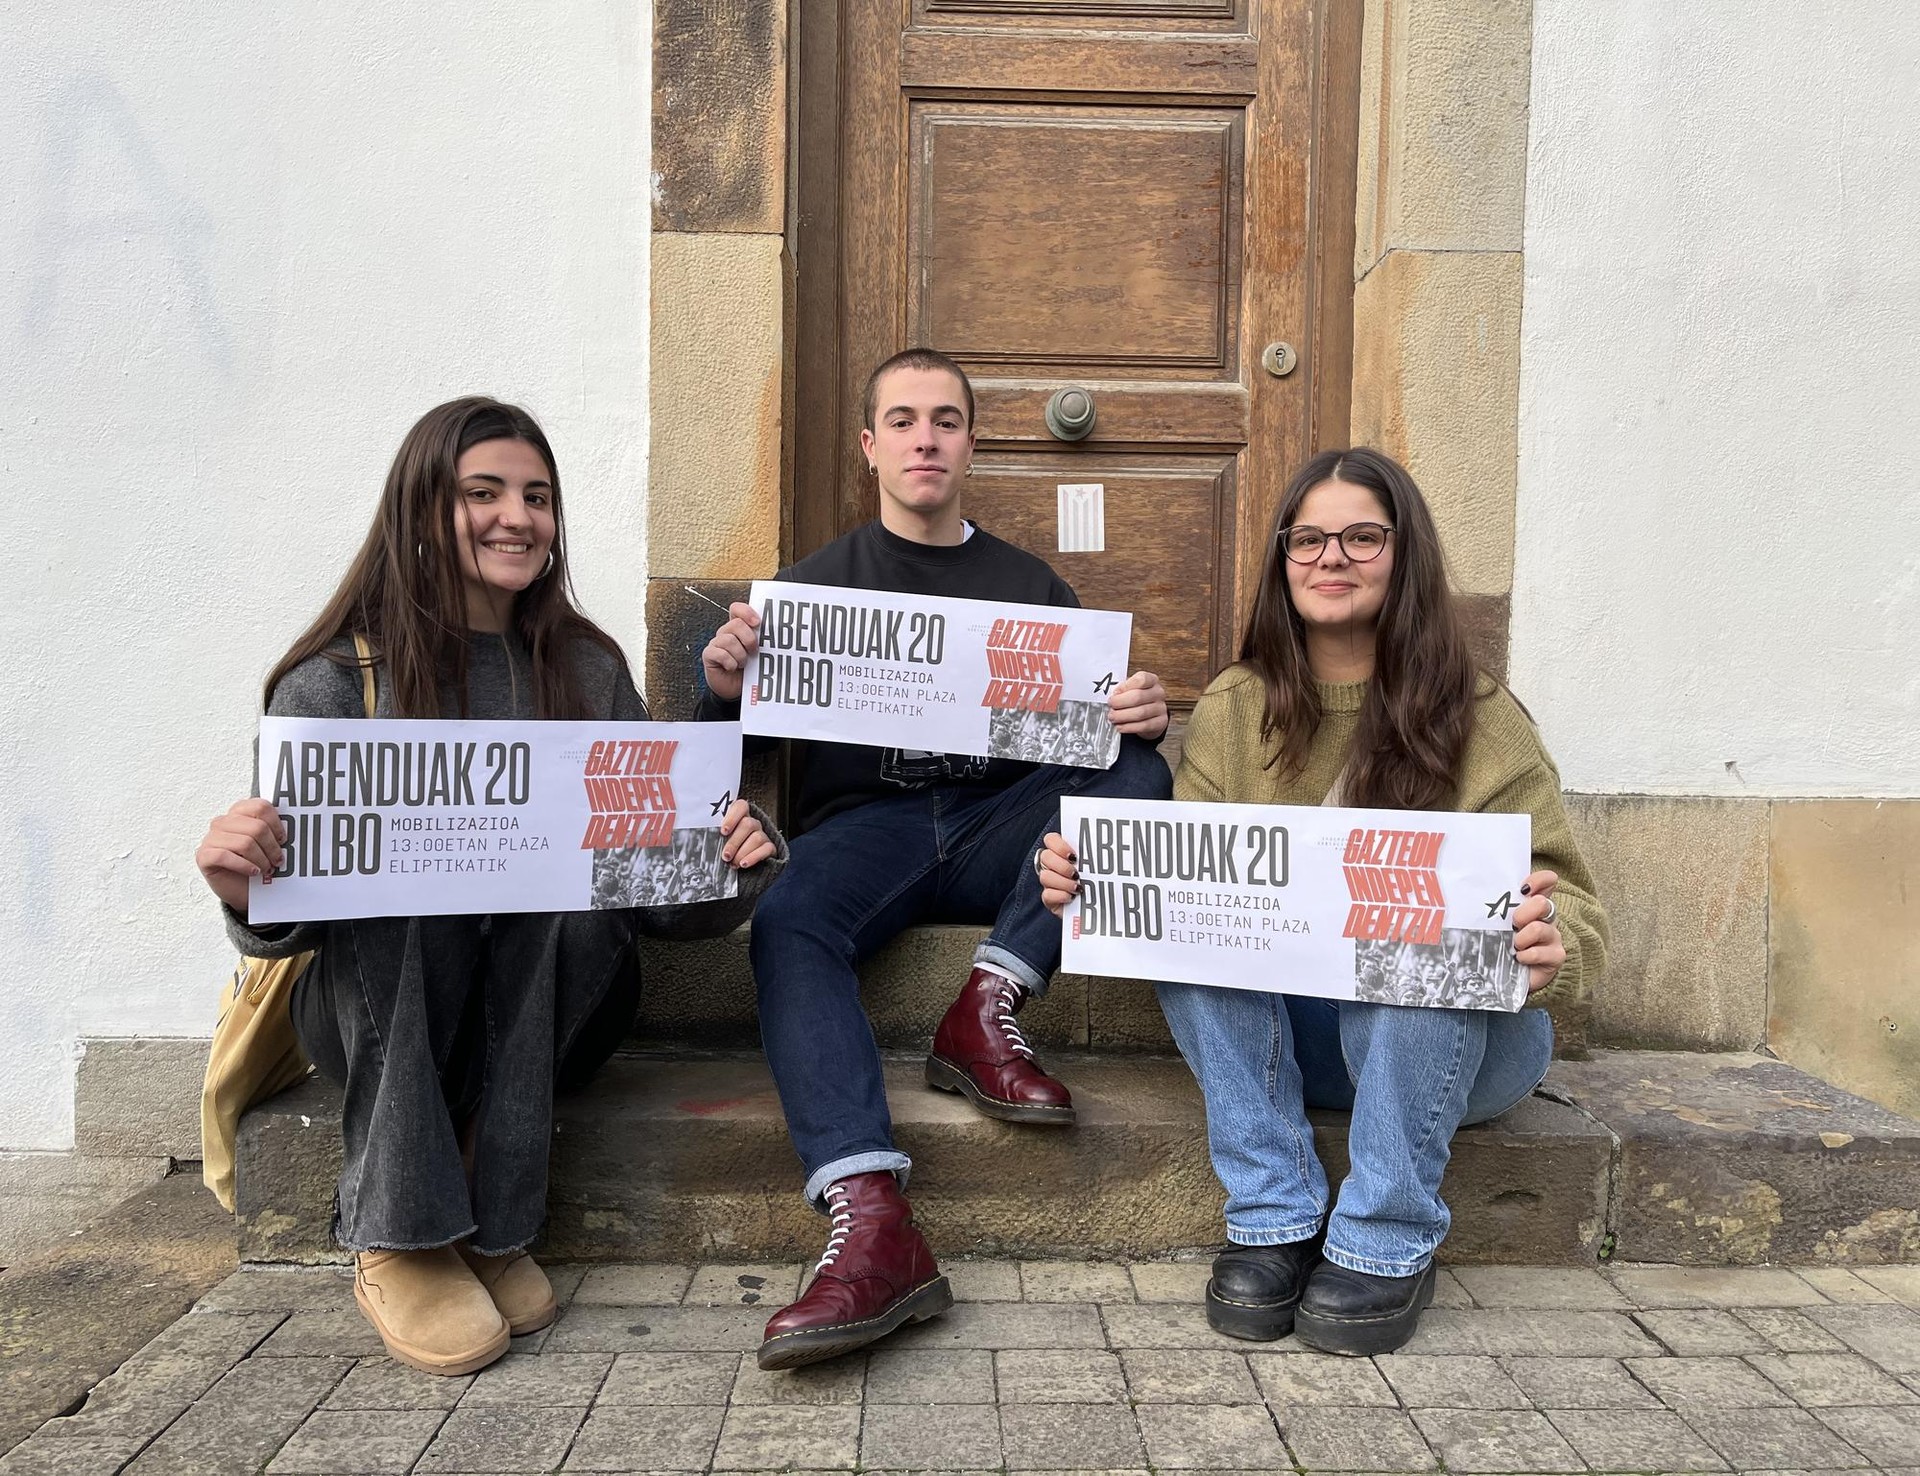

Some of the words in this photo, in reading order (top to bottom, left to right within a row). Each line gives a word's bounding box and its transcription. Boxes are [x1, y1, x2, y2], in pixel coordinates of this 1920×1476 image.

[759, 598, 904, 661] ABENDUAK
[908, 612, 946, 665] 20
[986, 618, 1069, 653] GAZTEON
[758, 652, 833, 708] BILBO
[839, 665, 934, 685] MOBILIZAZIOA
[986, 648, 1064, 684] INDEPEN
[838, 698, 924, 717] ELIPTIKATIK
[839, 681, 909, 699] 13:00ETAN
[917, 689, 957, 704] PLAZA
[981, 679, 1064, 714] DENTZIA
[272, 740, 477, 807] ABENDUAK
[484, 741, 531, 806] 20
[584, 740, 679, 776] GAZTEON
[584, 776, 677, 812] INDEPEN
[391, 816, 520, 831] MOBILIZAZIOA
[581, 812, 676, 850] DENTZIA
[391, 837, 488, 852] 13:00ETAN
[499, 836, 549, 851] PLAZA
[1078, 817, 1239, 884] ABENDUAK
[1247, 825, 1289, 887] 20
[1342, 828, 1445, 869] GAZTEON
[390, 858, 507, 873] ELIPTIKATIK
[1168, 890, 1281, 911] MOBILIZAZIOA
[1342, 865, 1445, 908] INDEPEN
[1080, 879, 1163, 941] BILBO
[1169, 910, 1252, 929] 13:00ETAN
[1262, 918, 1311, 934] PLAZA
[1342, 903, 1445, 946] DENTZIA
[1170, 929, 1271, 951] ELIPTIKATIK
